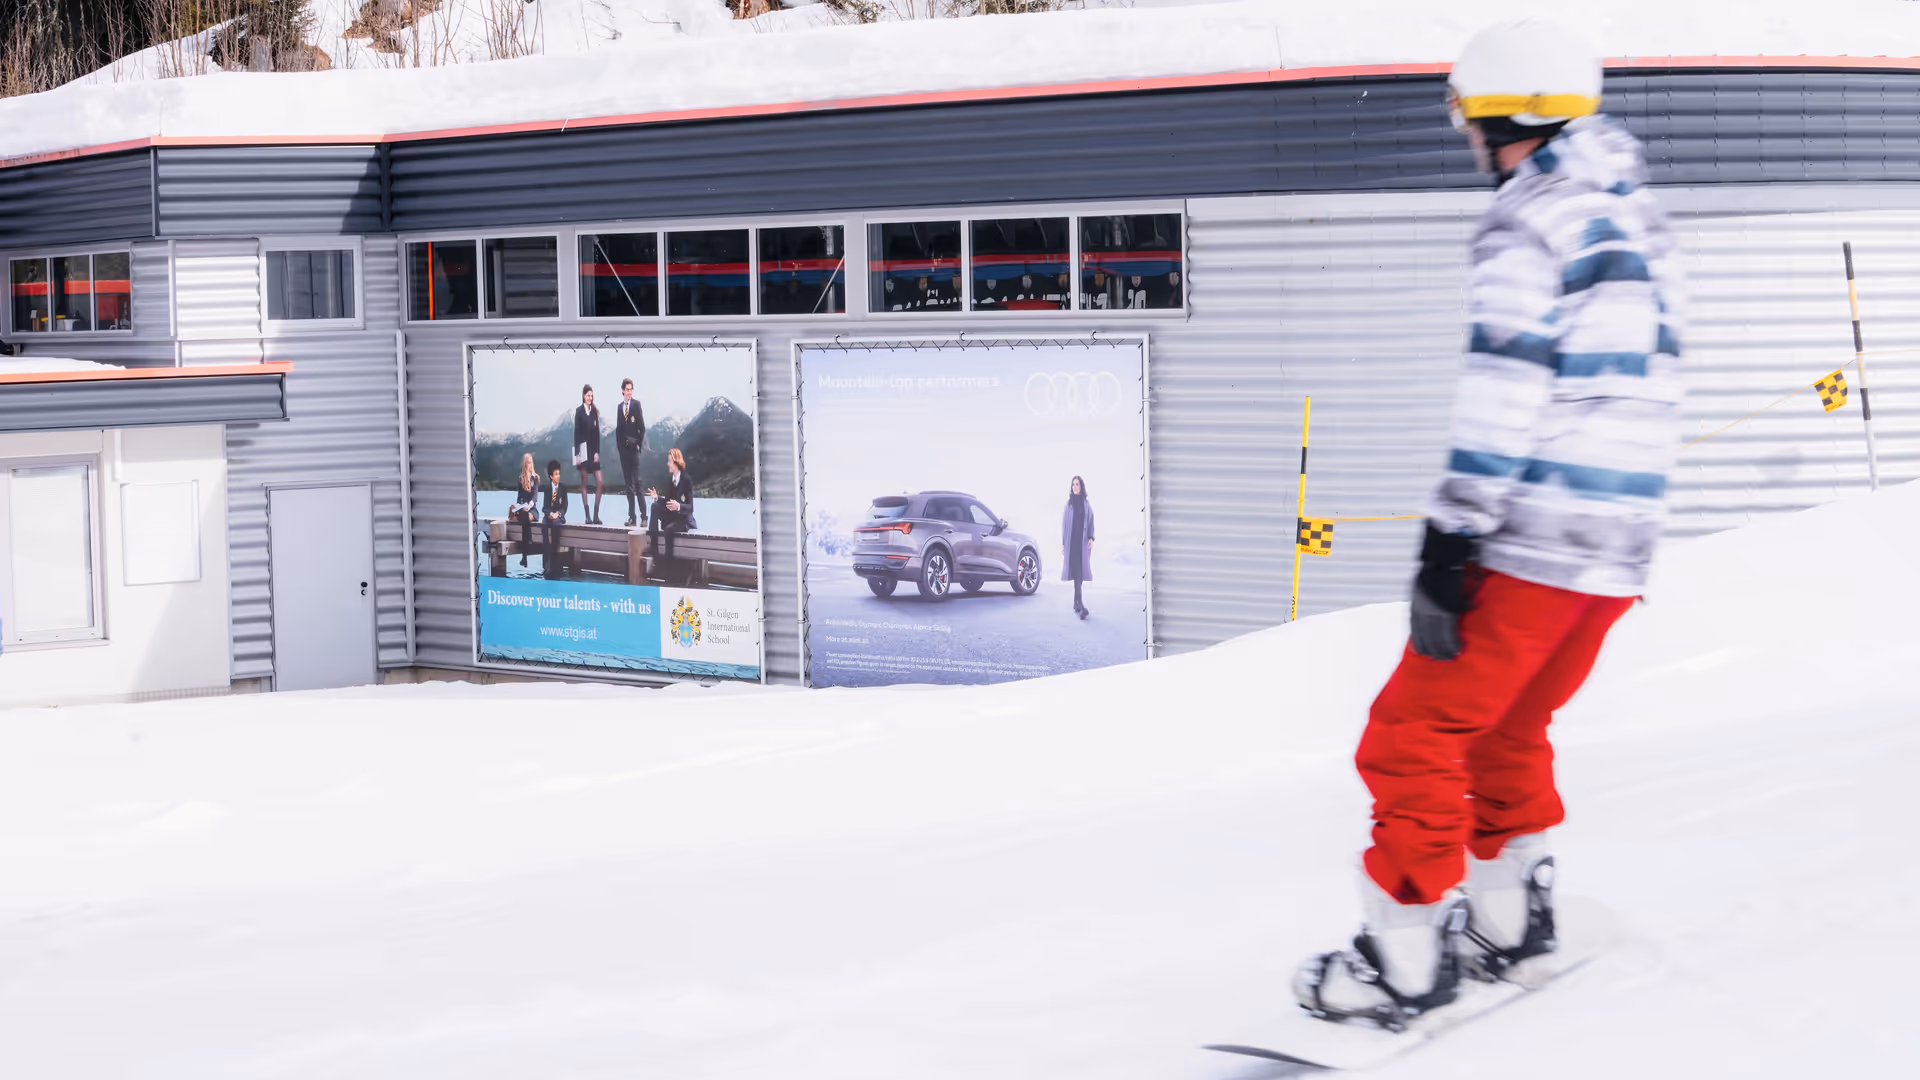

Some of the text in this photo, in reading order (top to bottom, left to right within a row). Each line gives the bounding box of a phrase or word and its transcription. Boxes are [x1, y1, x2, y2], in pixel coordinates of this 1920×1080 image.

[487, 589, 535, 607] Discover
[536, 596, 562, 612] your
[564, 594, 601, 612] talents
[610, 598, 636, 614] with
[638, 603, 652, 615] us
[706, 608, 739, 621] St. Gilgen
[539, 625, 597, 642] www.stgis.at
[706, 621, 751, 633] International
[707, 634, 730, 645] School
